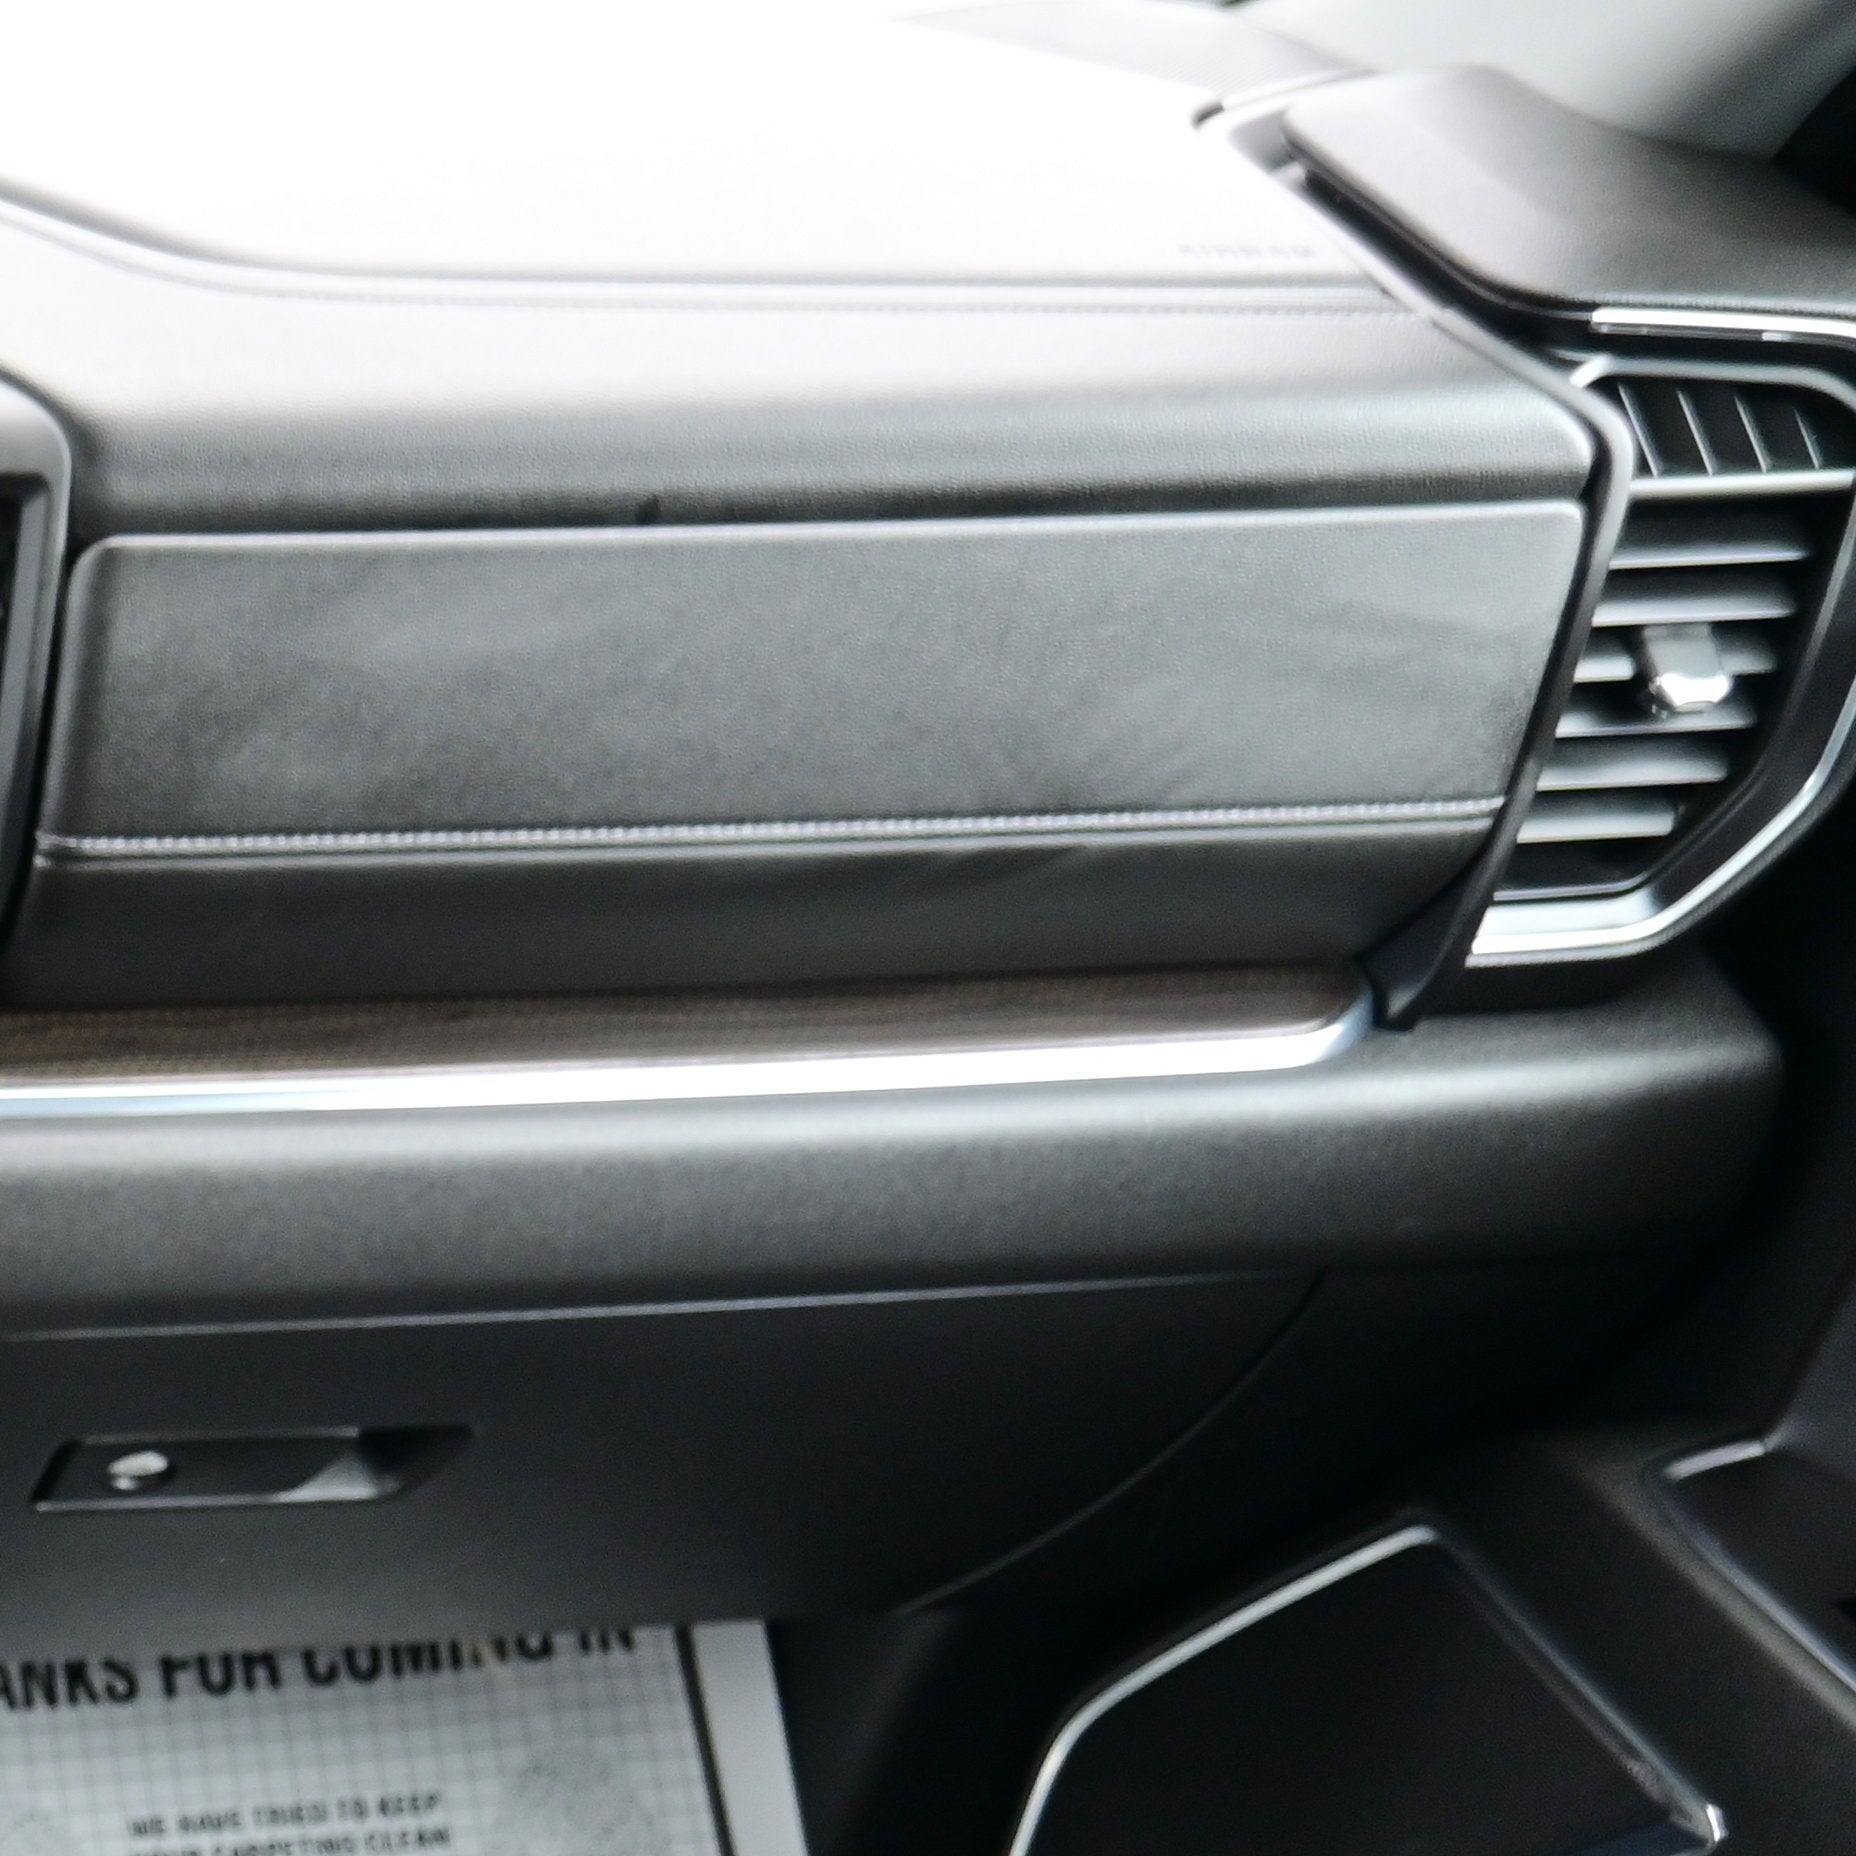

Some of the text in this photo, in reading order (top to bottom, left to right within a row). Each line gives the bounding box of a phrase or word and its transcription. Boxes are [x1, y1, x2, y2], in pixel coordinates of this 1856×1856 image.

[337, 1797, 370, 1822] TO
[378, 1789, 441, 1818] KEEP
[365, 1826, 449, 1855] CLEAN
